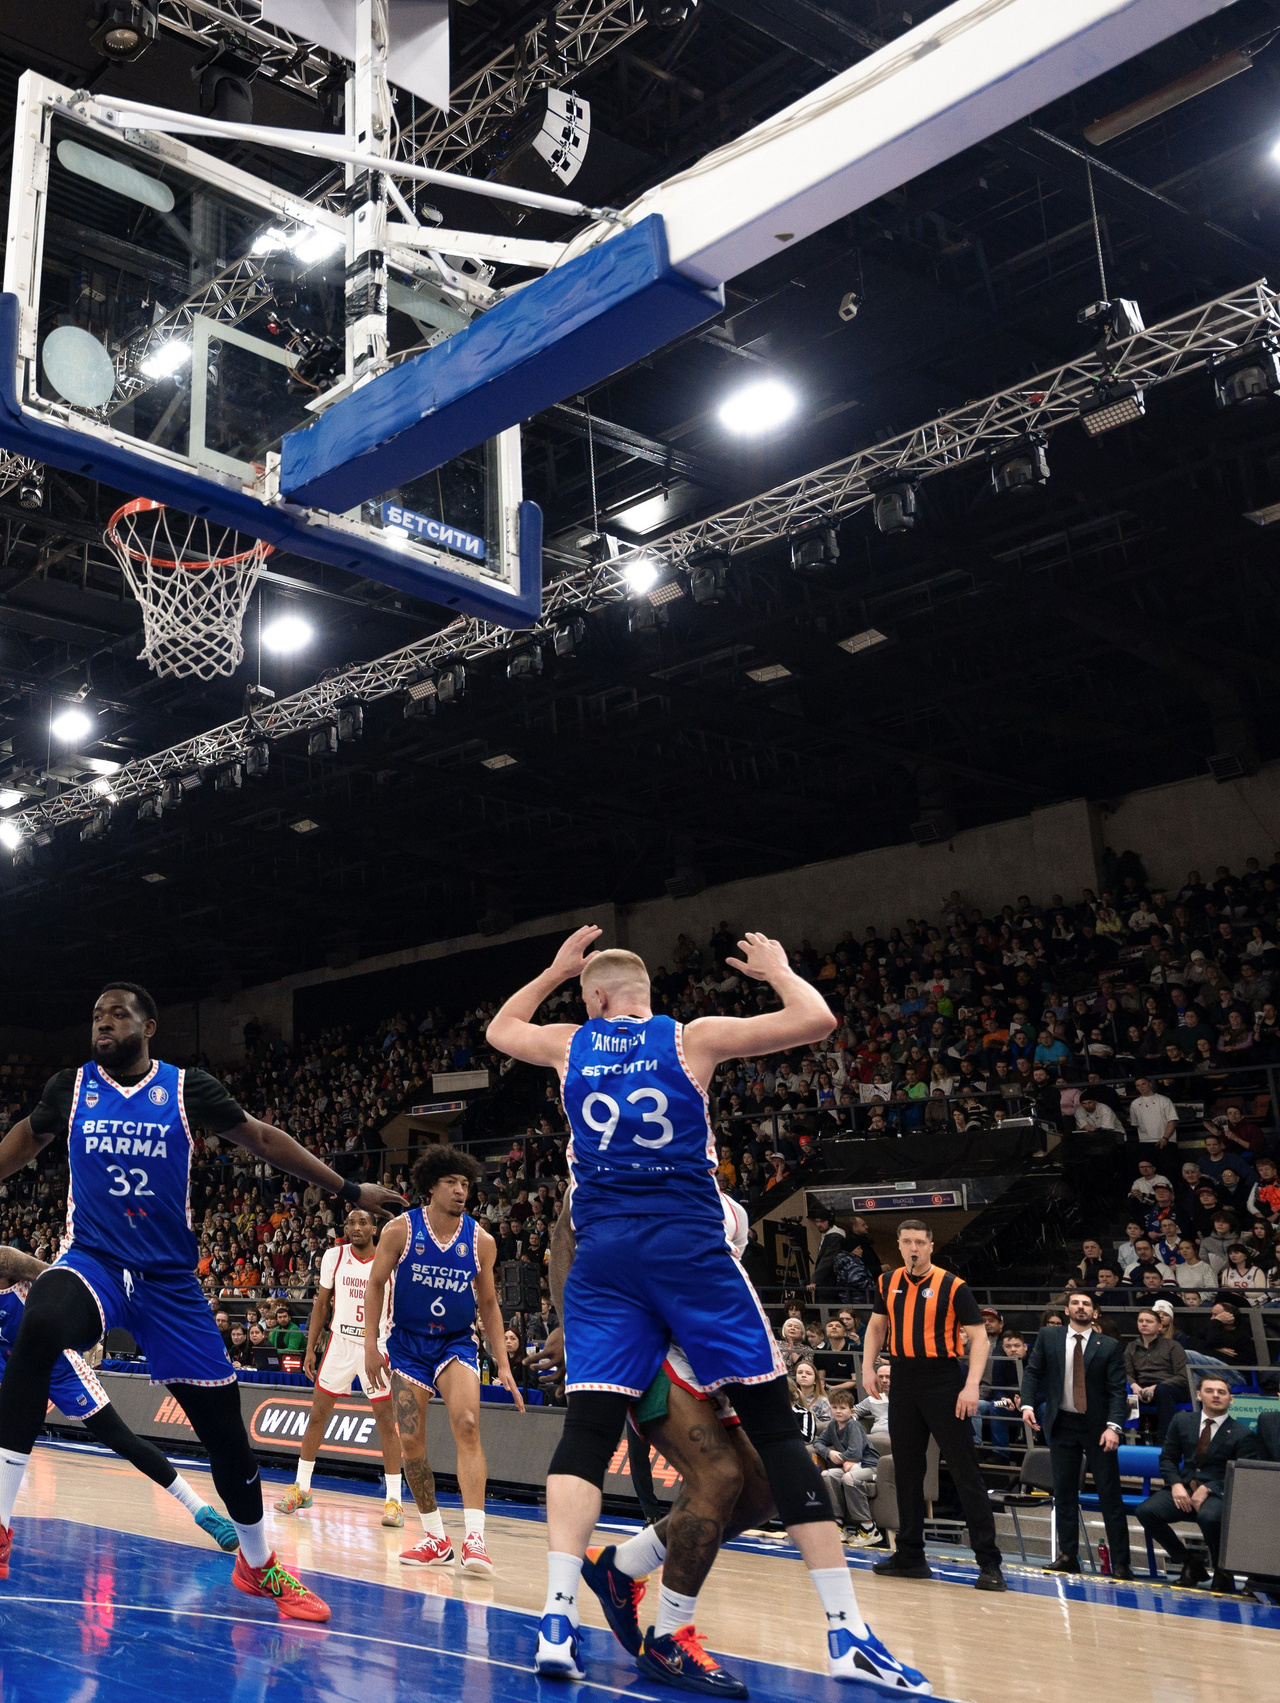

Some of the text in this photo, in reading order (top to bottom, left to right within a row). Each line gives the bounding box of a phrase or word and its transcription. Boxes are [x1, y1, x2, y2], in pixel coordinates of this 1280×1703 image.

[387, 506, 480, 554] БЕТСИТИ
[581, 1059, 658, 1077] БЕТСИТИ
[82, 1119, 170, 1138] BETCITY
[582, 1087, 674, 1151] 93
[85, 1136, 168, 1159] PARMA
[106, 1164, 156, 1196] 32
[342, 1275, 368, 1288] LOKOM
[410, 1263, 472, 1280] BETCITY
[412, 1272, 469, 1293] PARMA
[430, 1296, 446, 1317] 6
[260, 1408, 376, 1443] WININE
